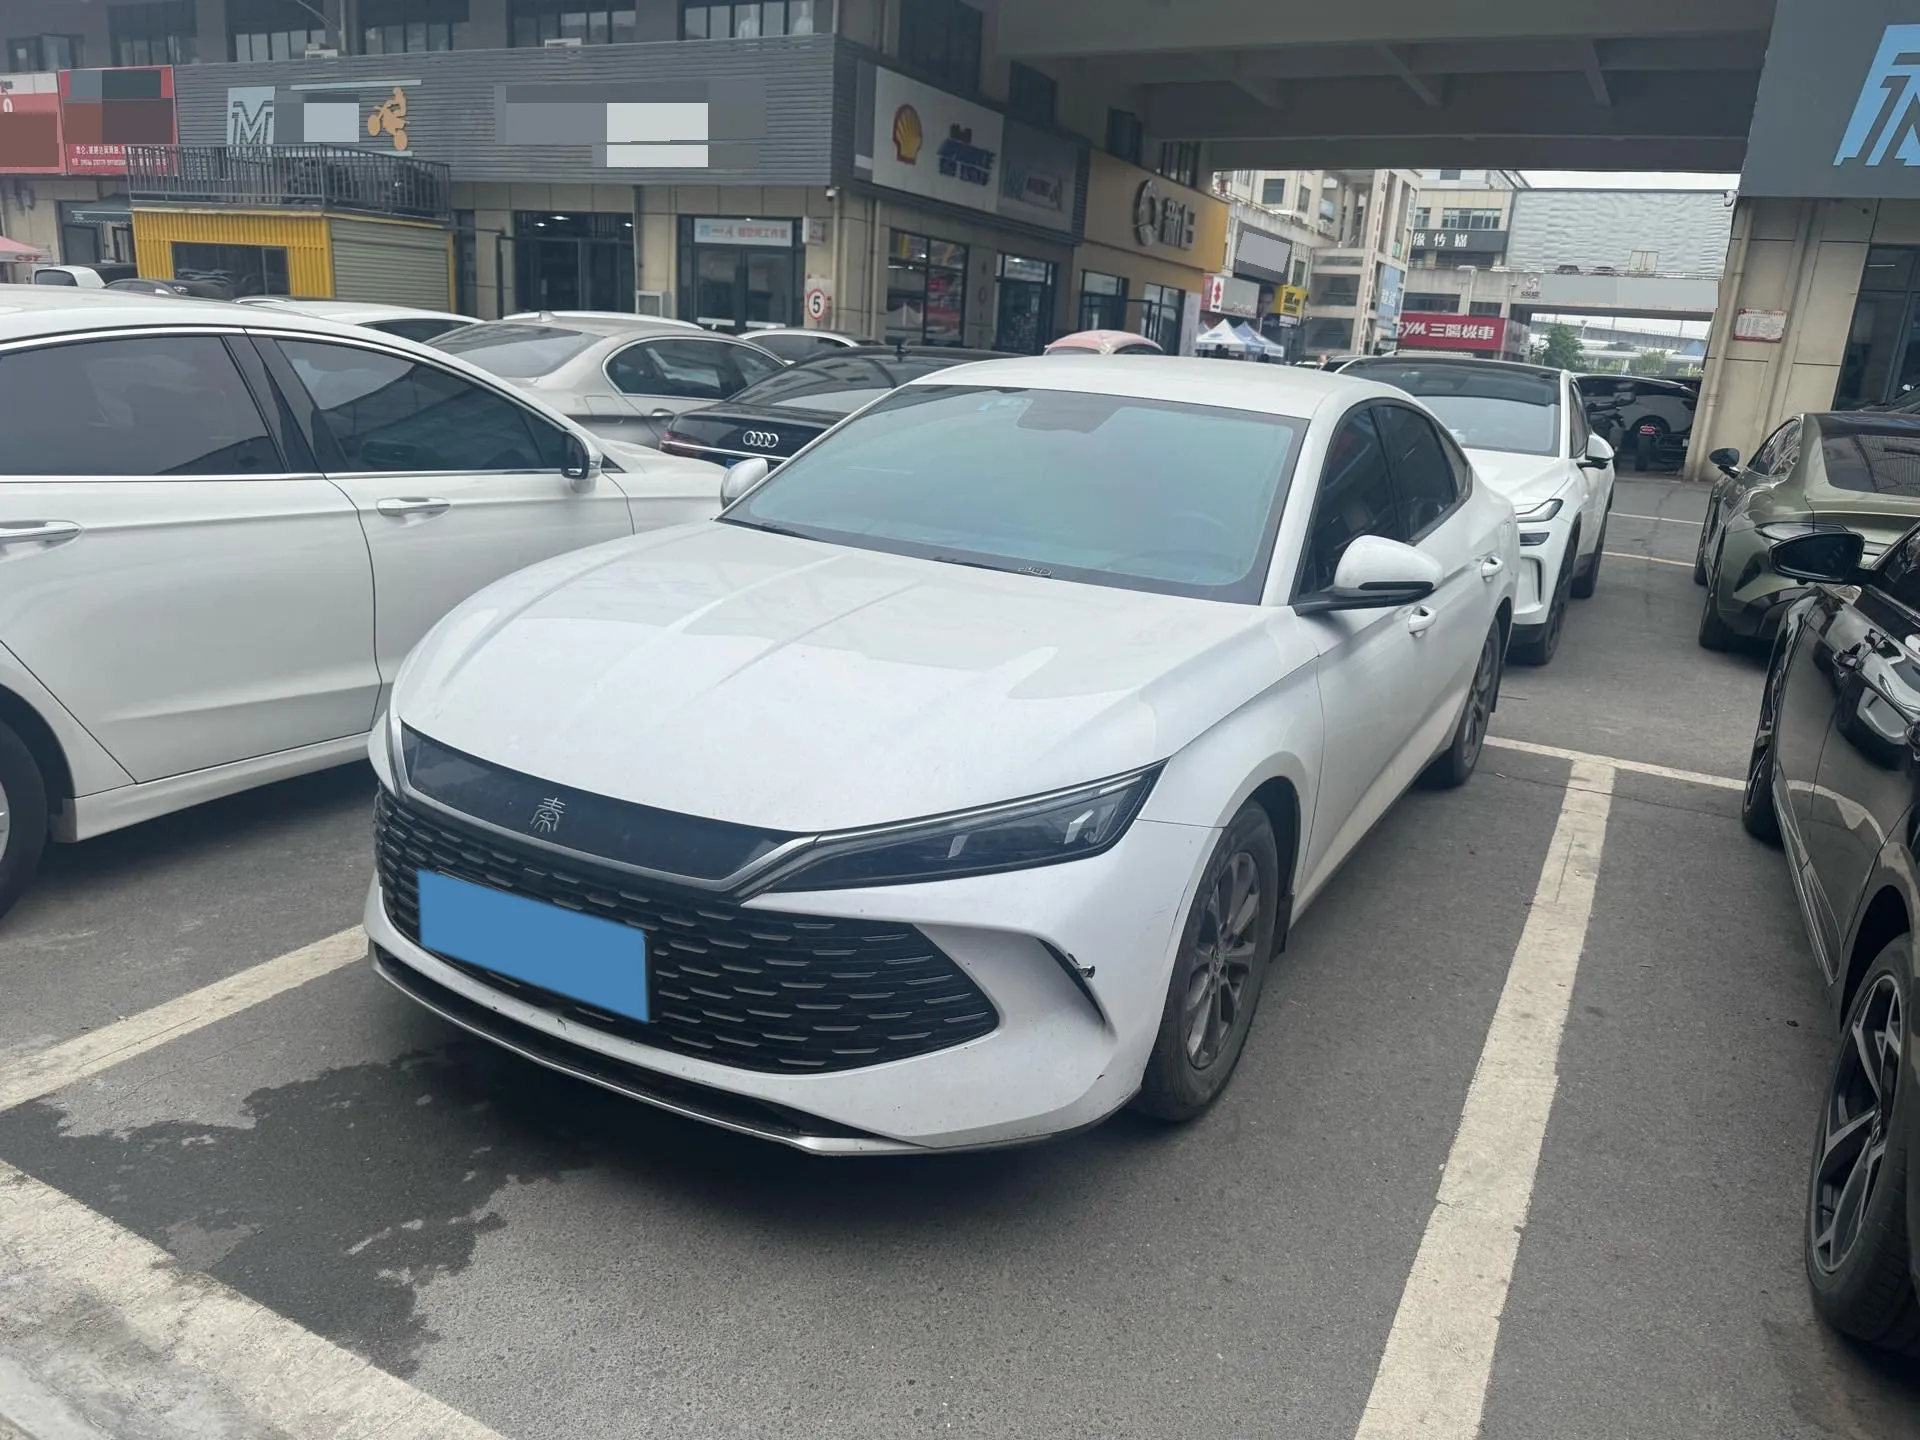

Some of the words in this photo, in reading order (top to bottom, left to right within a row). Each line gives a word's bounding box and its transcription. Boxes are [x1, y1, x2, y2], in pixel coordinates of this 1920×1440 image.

[812, 295, 821, 314] 5
[1428, 323, 1495, 340] 三陽機車
